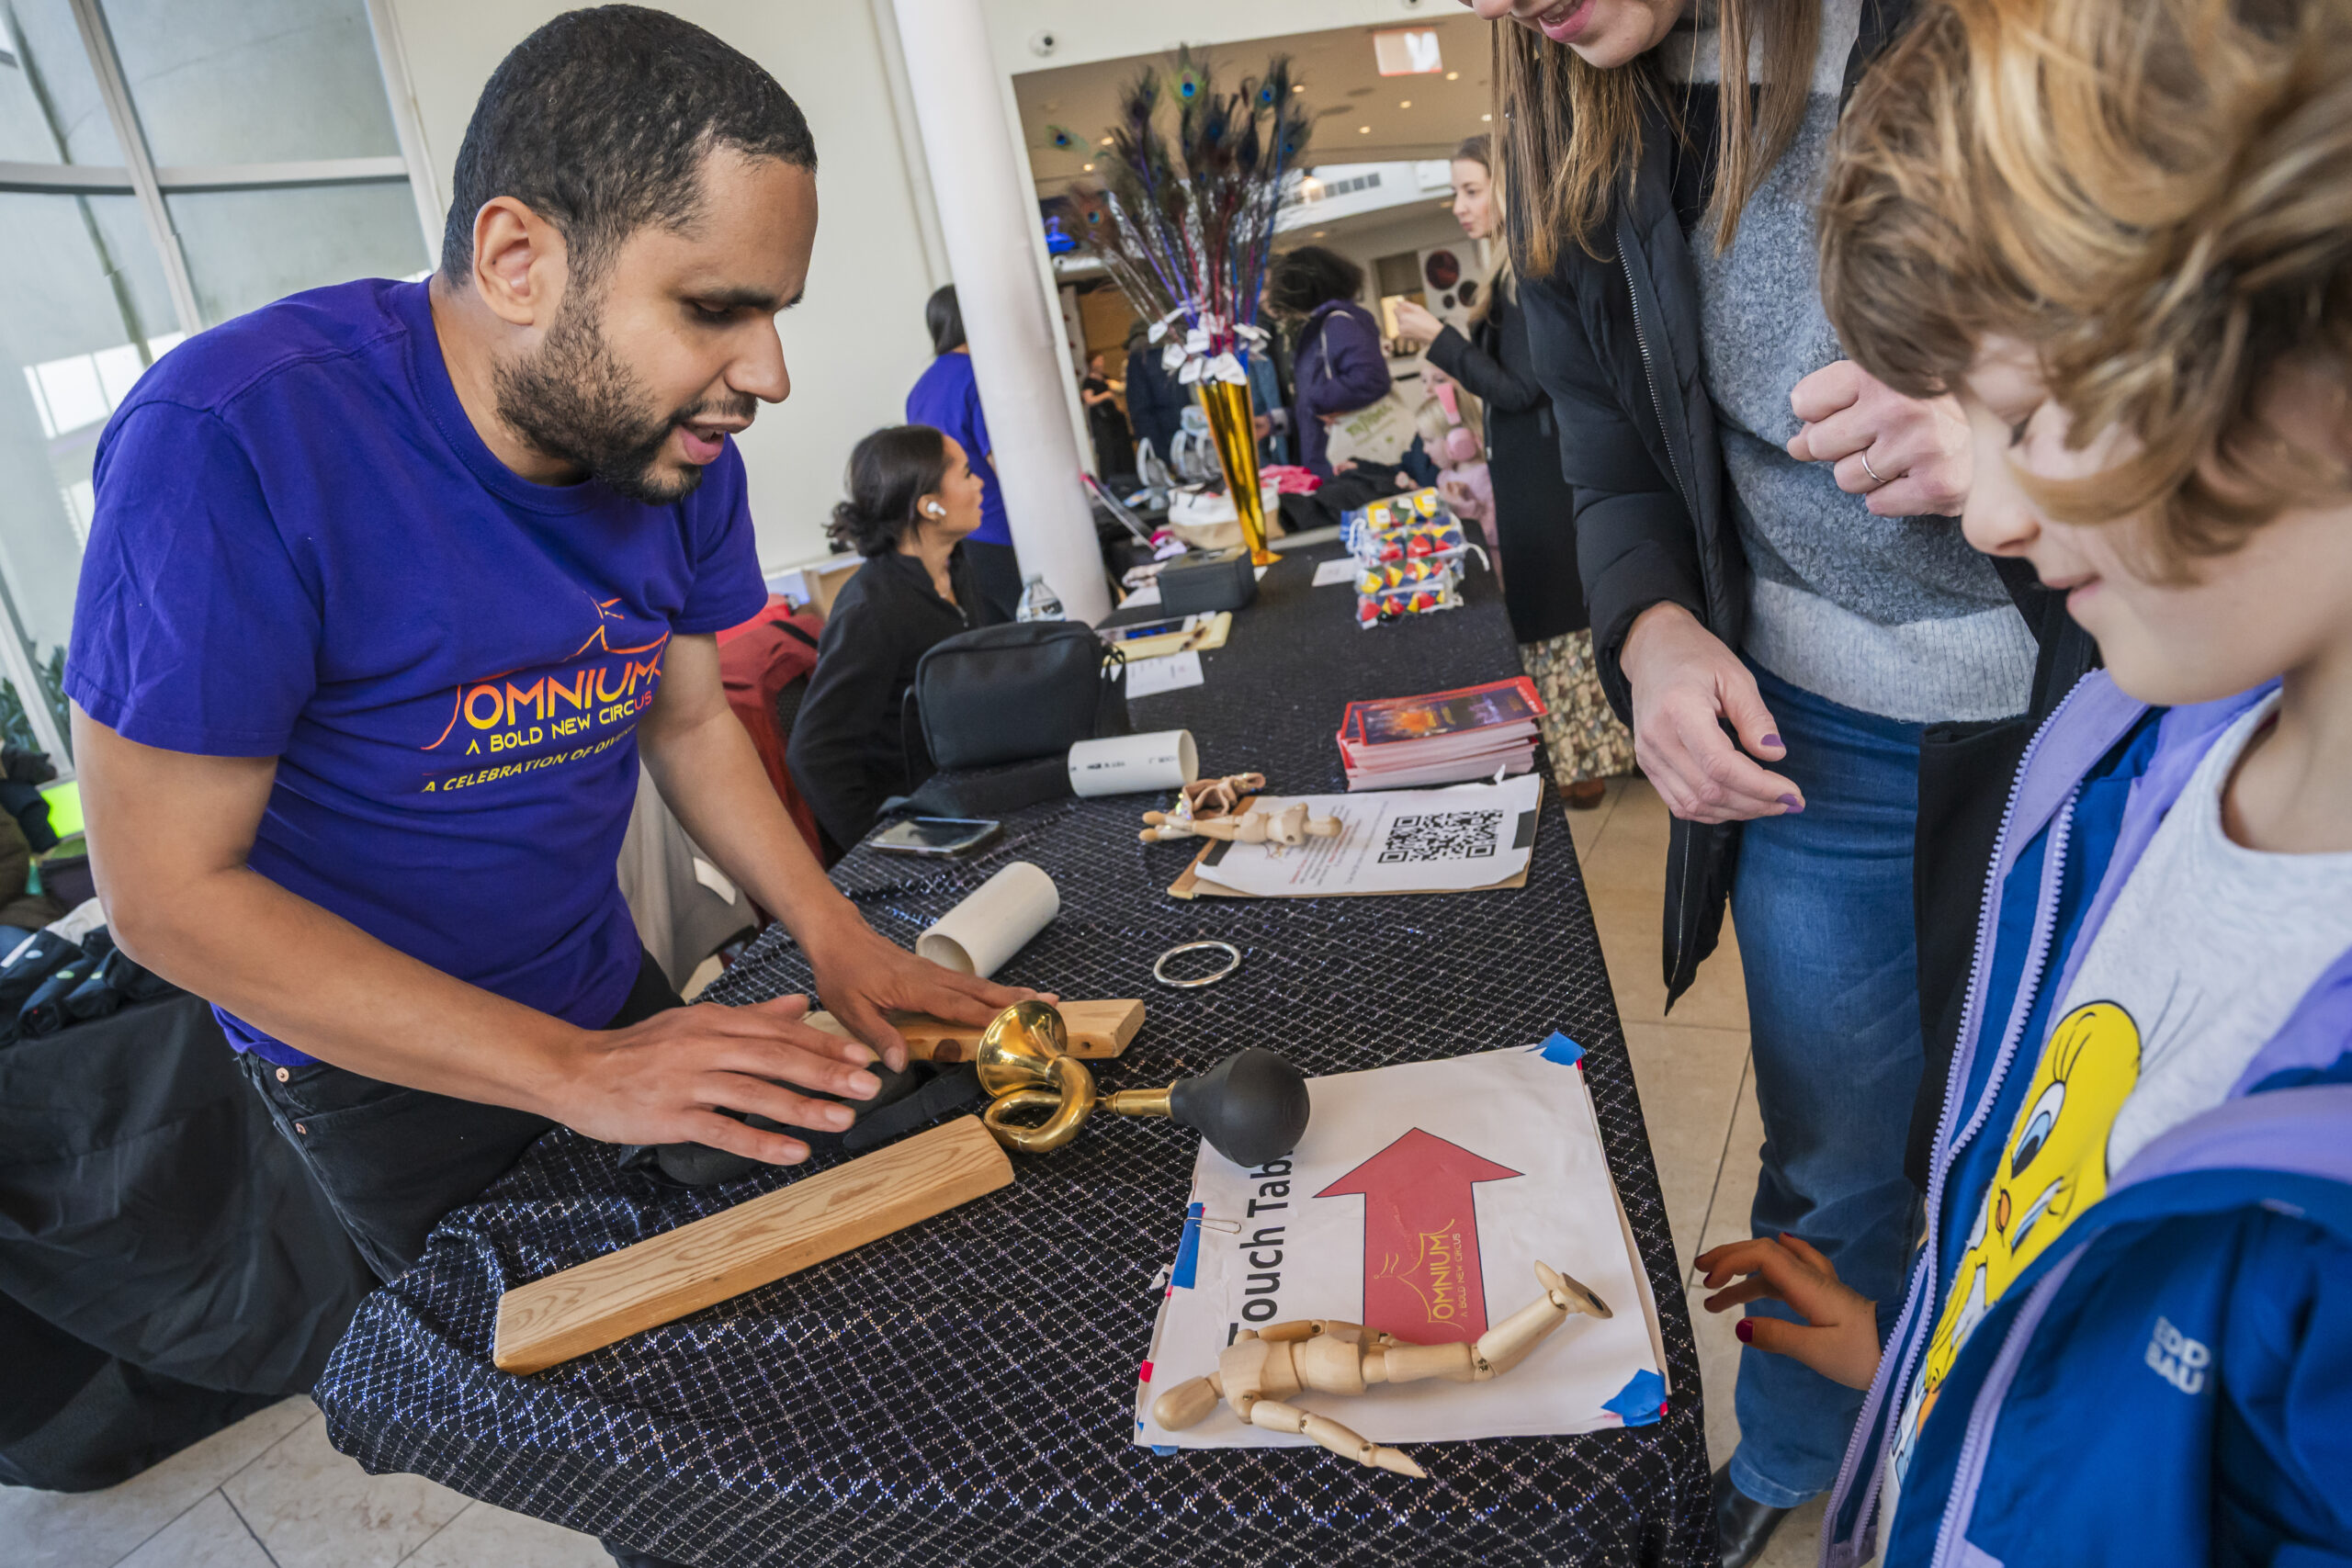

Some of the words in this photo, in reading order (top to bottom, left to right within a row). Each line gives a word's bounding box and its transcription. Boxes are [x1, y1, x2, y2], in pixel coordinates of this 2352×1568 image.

[463, 654, 662, 730] OMNIUM
[466, 739, 481, 756] A
[490, 726, 544, 752] BOLD
[551, 713, 591, 739] NEW
[599, 691, 653, 726] CIRCUS
[421, 781, 435, 793] A
[443, 752, 569, 791] CELEBRATION
[571, 746, 594, 761] OF
[1247, 1150, 1294, 1218] Tab
[1452, 1233, 1463, 1263] CIRCUS
[1455, 1265, 1465, 1284] NEW
[1429, 1235, 1455, 1320] OMNIUM
[1457, 1286, 1467, 1309] BOLD
